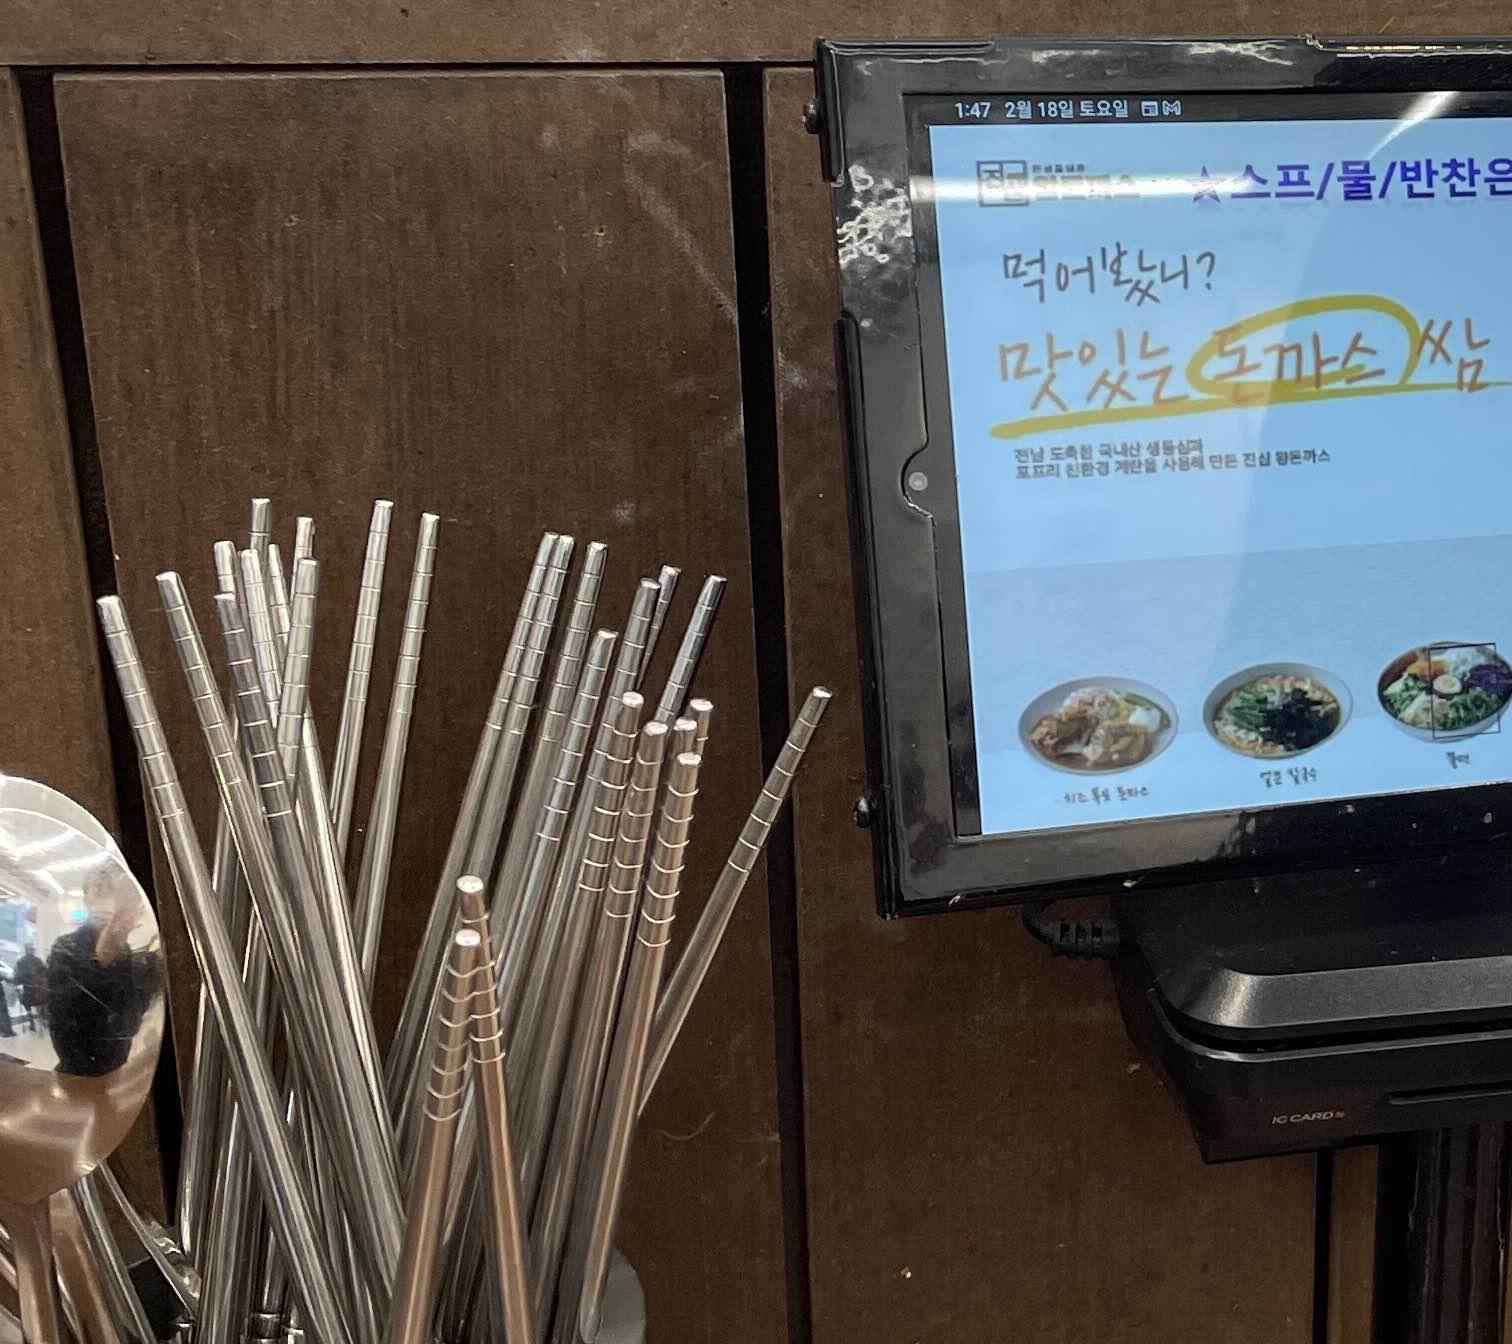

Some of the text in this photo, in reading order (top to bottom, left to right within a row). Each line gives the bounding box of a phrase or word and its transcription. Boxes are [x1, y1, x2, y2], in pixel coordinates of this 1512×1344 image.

[955, 99, 1129, 119] 1:47 2월 18일 토요일
[999, 317, 1491, 412] 맛있는 돈까스 쌈
[1243, 450, 1272, 467] 진심
[1289, 1111, 1334, 1123] CARD
